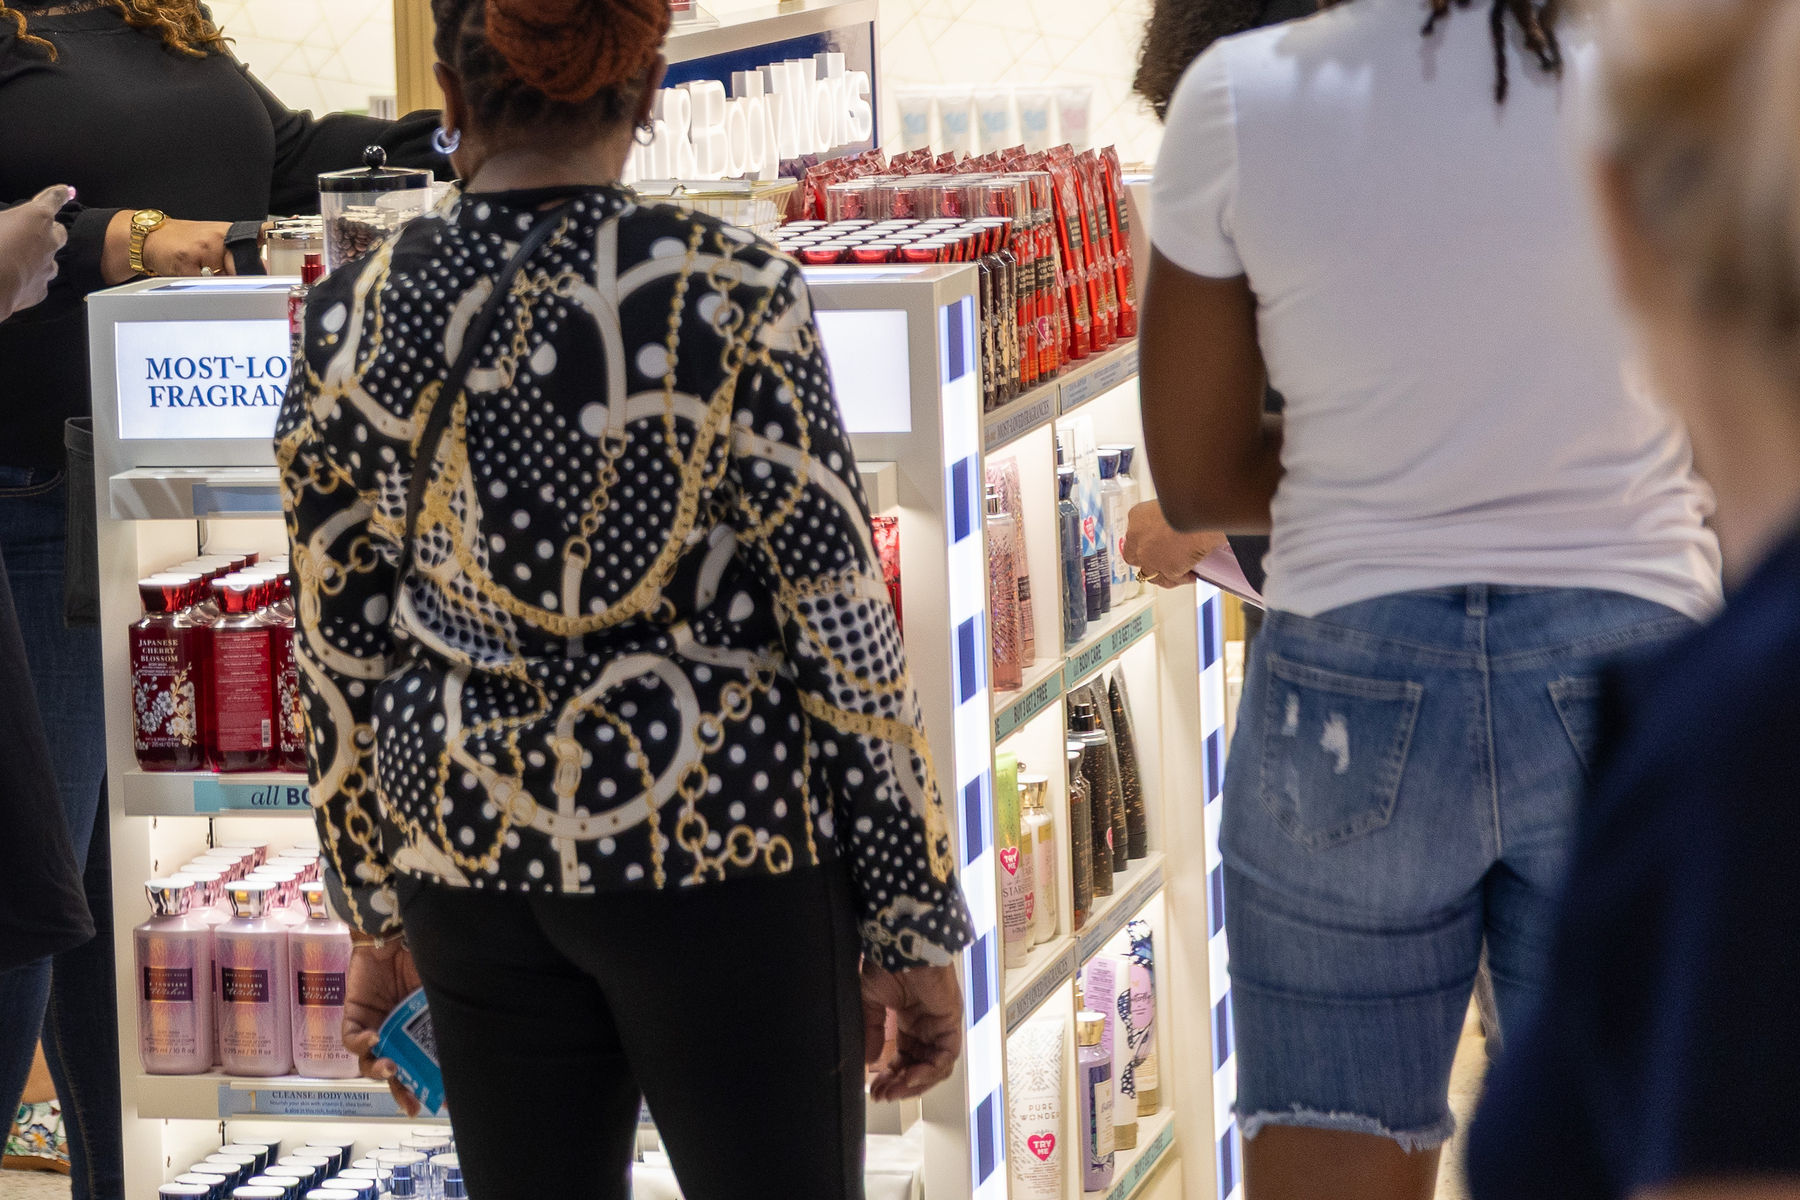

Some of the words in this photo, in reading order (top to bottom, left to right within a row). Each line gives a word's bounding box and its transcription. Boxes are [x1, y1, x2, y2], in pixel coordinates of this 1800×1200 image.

[145, 356, 291, 379] MOST-LO
[138, 639, 179, 647] JAPANESE
[141, 655, 179, 663] BLOSSOM
[251, 785, 280, 805] all
[1003, 852, 1017, 863] TRY
[272, 1091, 315, 1099] CLEANSE:
[317, 1092, 342, 1100] BODY
[342, 1092, 370, 1100] WASH
[248, 1091, 260, 1112] 1
[1028, 1103, 1053, 1111] PURE
[1033, 1140, 1052, 1149] TRY
